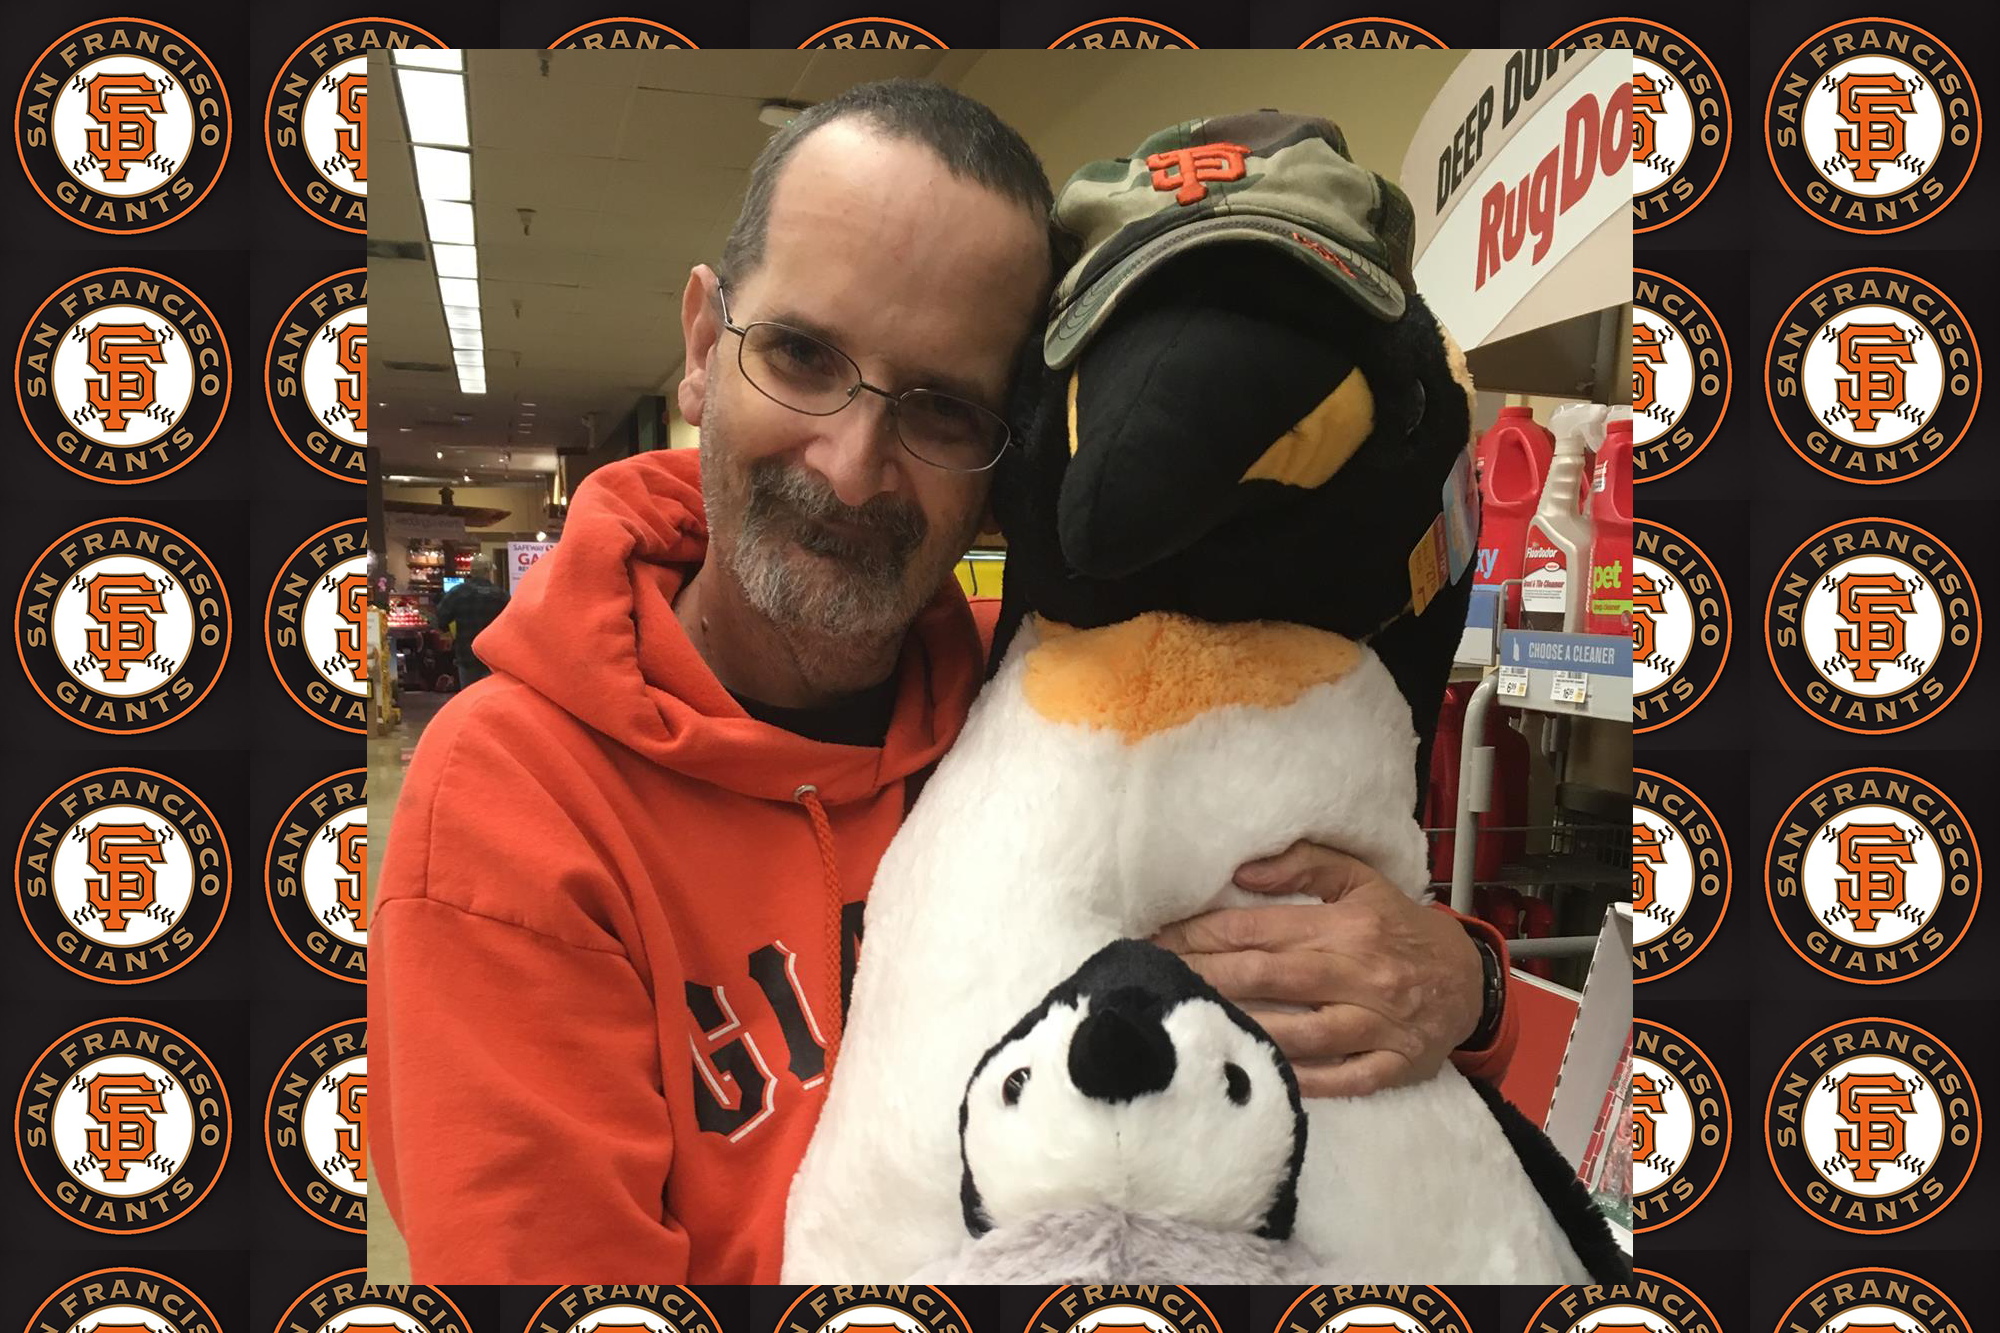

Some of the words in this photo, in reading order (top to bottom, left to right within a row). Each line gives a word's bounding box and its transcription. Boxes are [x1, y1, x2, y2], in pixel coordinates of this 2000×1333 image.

[27, 72, 59, 148] SAN
[59, 29, 221, 146] FRANCISCO
[277, 72, 309, 148] SAN
[1570, 29, 1721, 146] RANCISCO
[1777, 72, 1809, 148] SAN
[1809, 29, 1971, 146] FRANCISCO
[1436, 85, 1494, 216] DEEP
[56, 177, 194, 223] GIANTS
[306, 177, 367, 222] GIA
[1633, 177, 1694, 222] NTS
[1806, 177, 1944, 223] GIANTS
[27, 322, 59, 398] SAN
[59, 279, 221, 396] FRANCISCO
[277, 322, 309, 398] SAN
[1633, 281, 1721, 396] NCISCO
[1777, 322, 1809, 398] SAN
[1809, 279, 1971, 396] FRANCISCO
[56, 427, 194, 473] GIANTS
[306, 427, 367, 472] GIA
[1633, 427, 1694, 472] NTS
[1806, 427, 1944, 473] GIANTS
[27, 572, 59, 648] SAN
[59, 529, 221, 646] FRANCISCO
[1594, 560, 1622, 591] pet
[1633, 531, 1721, 646] NCISCO
[1777, 572, 1809, 648] SAN
[1809, 529, 1971, 646] FRANCISCO
[277, 572, 309, 648] SAN
[1528, 641, 1563, 661] CHOOSE
[1565, 644, 1571, 661] A
[1573, 645, 1615, 665] CLEANER
[56, 677, 194, 723] GIANTS
[306, 677, 367, 722] GIA
[1633, 677, 1694, 722] NTS
[1806, 677, 1944, 723] GIANTS
[27, 822, 59, 898] SAN
[59, 779, 221, 896] FRANCISCO
[277, 822, 309, 898] SAN
[1633, 781, 1721, 896] NCISCO
[1777, 822, 1809, 898] SAN
[1809, 779, 1971, 896] FRANCISCO
[56, 927, 194, 973] GIANTS
[306, 927, 367, 972] GIA
[1633, 927, 1694, 972] NTS
[1806, 927, 1944, 973] GIANTS
[27, 1072, 59, 1148] SAN
[59, 1029, 221, 1146] FRANCISCO
[277, 1072, 309, 1148] SAN
[1633, 1031, 1721, 1146] NCISCO
[1777, 1072, 1809, 1148] SAN
[1809, 1029, 1971, 1146] FRANCISCO
[56, 1177, 194, 1223] GIANTS
[306, 1177, 367, 1222] GIA
[1633, 1177, 1694, 1222] NTS
[1806, 1177, 1944, 1223] GIANTS
[60, 1280, 209, 1333] FRANCI
[310, 1280, 459, 1333] FRANCI
[560, 1285, 709, 1333] FRANCI
[810, 1285, 959, 1333] FRANCI
[1060, 1285, 1209, 1333] FRANCI
[1310, 1285, 1459, 1333] FRANCI
[1560, 1281, 1709, 1333] FRANCI
[1810, 1280, 1959, 1333] FRANCI
